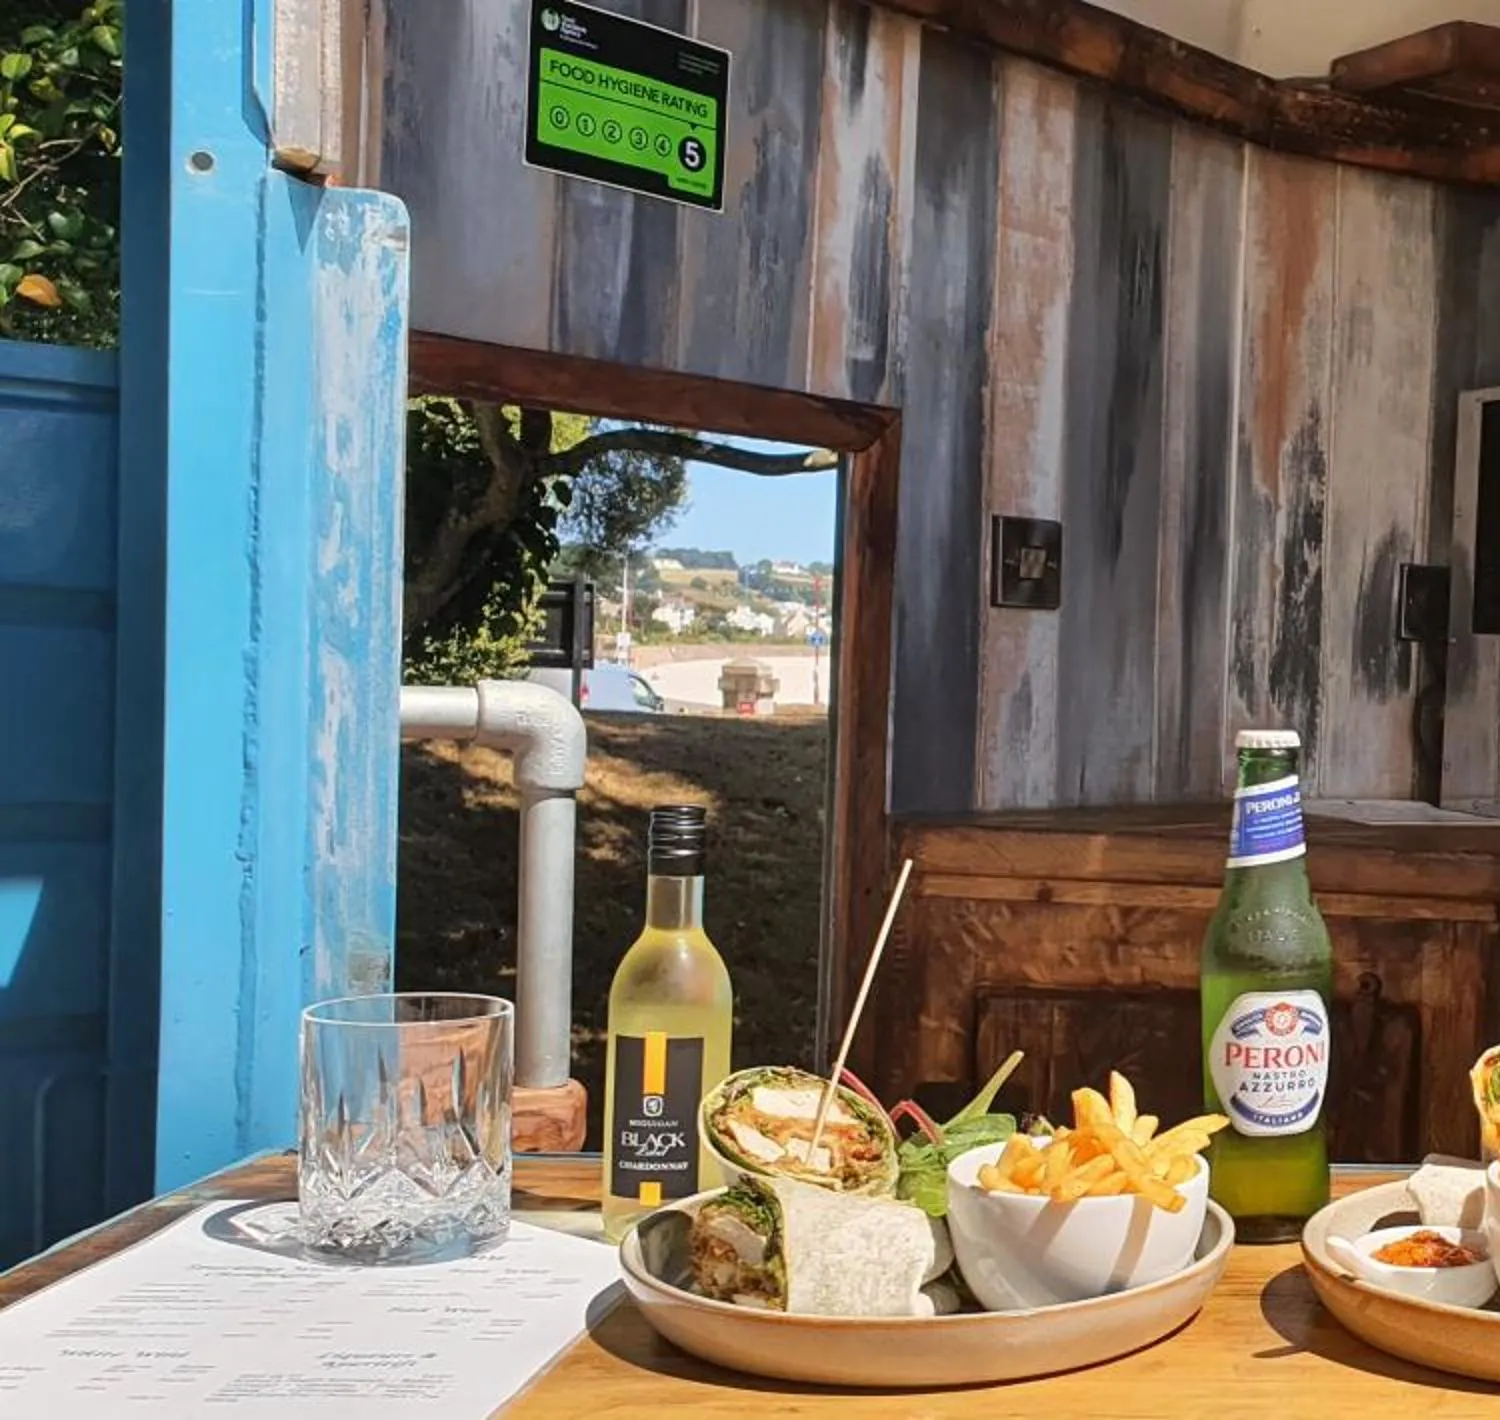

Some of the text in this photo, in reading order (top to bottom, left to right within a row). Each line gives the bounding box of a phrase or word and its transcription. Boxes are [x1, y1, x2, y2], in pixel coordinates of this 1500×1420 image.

[550, 59, 708, 118] FOOD HYGIENE RATING
[684, 141, 700, 168] 5
[1224, 1041, 1325, 1069] PERONI
[1252, 1070, 1306, 1080] NASTRO
[1239, 1077, 1315, 1093] AZZURRO
[621, 1131, 686, 1148] BLACK
[618, 1160, 689, 1172] CHARDONNAY
